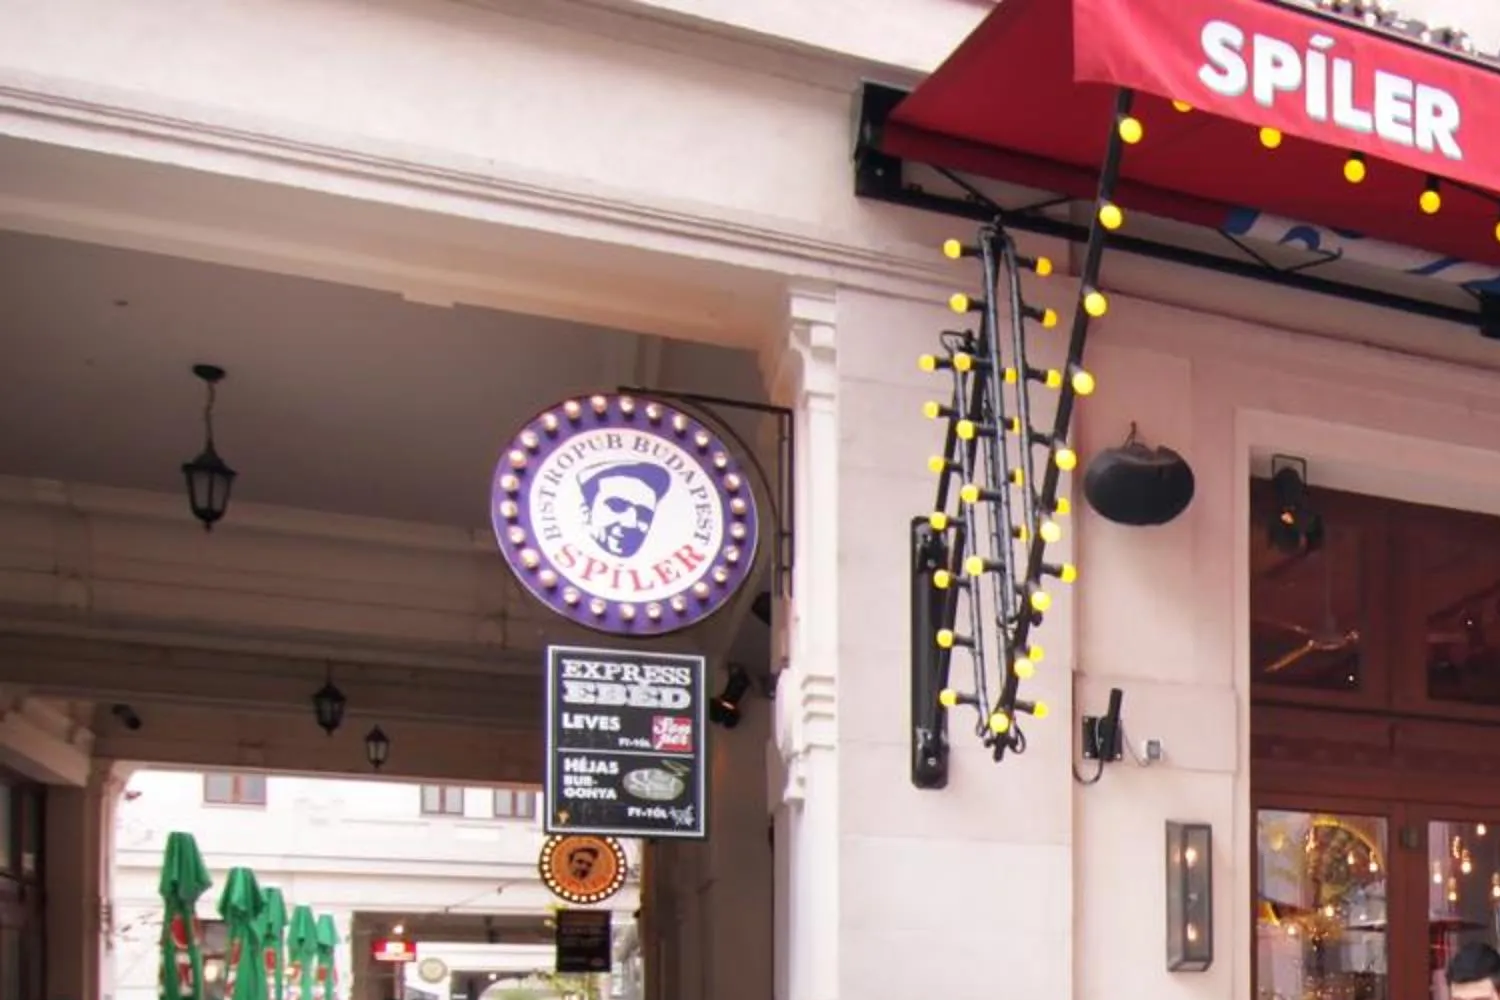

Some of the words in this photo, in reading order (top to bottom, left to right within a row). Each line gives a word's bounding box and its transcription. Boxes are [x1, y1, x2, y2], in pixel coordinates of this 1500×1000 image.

[1199, 20, 1463, 160] SPÍLER
[537, 432, 623, 541] BISTROPUB
[633, 434, 713, 546] BUDAPEST
[561, 659, 692, 686] EXPRESS
[562, 680, 692, 709] EBÉD
[562, 712, 621, 731] LEVES
[563, 757, 619, 774] HÉJAS
